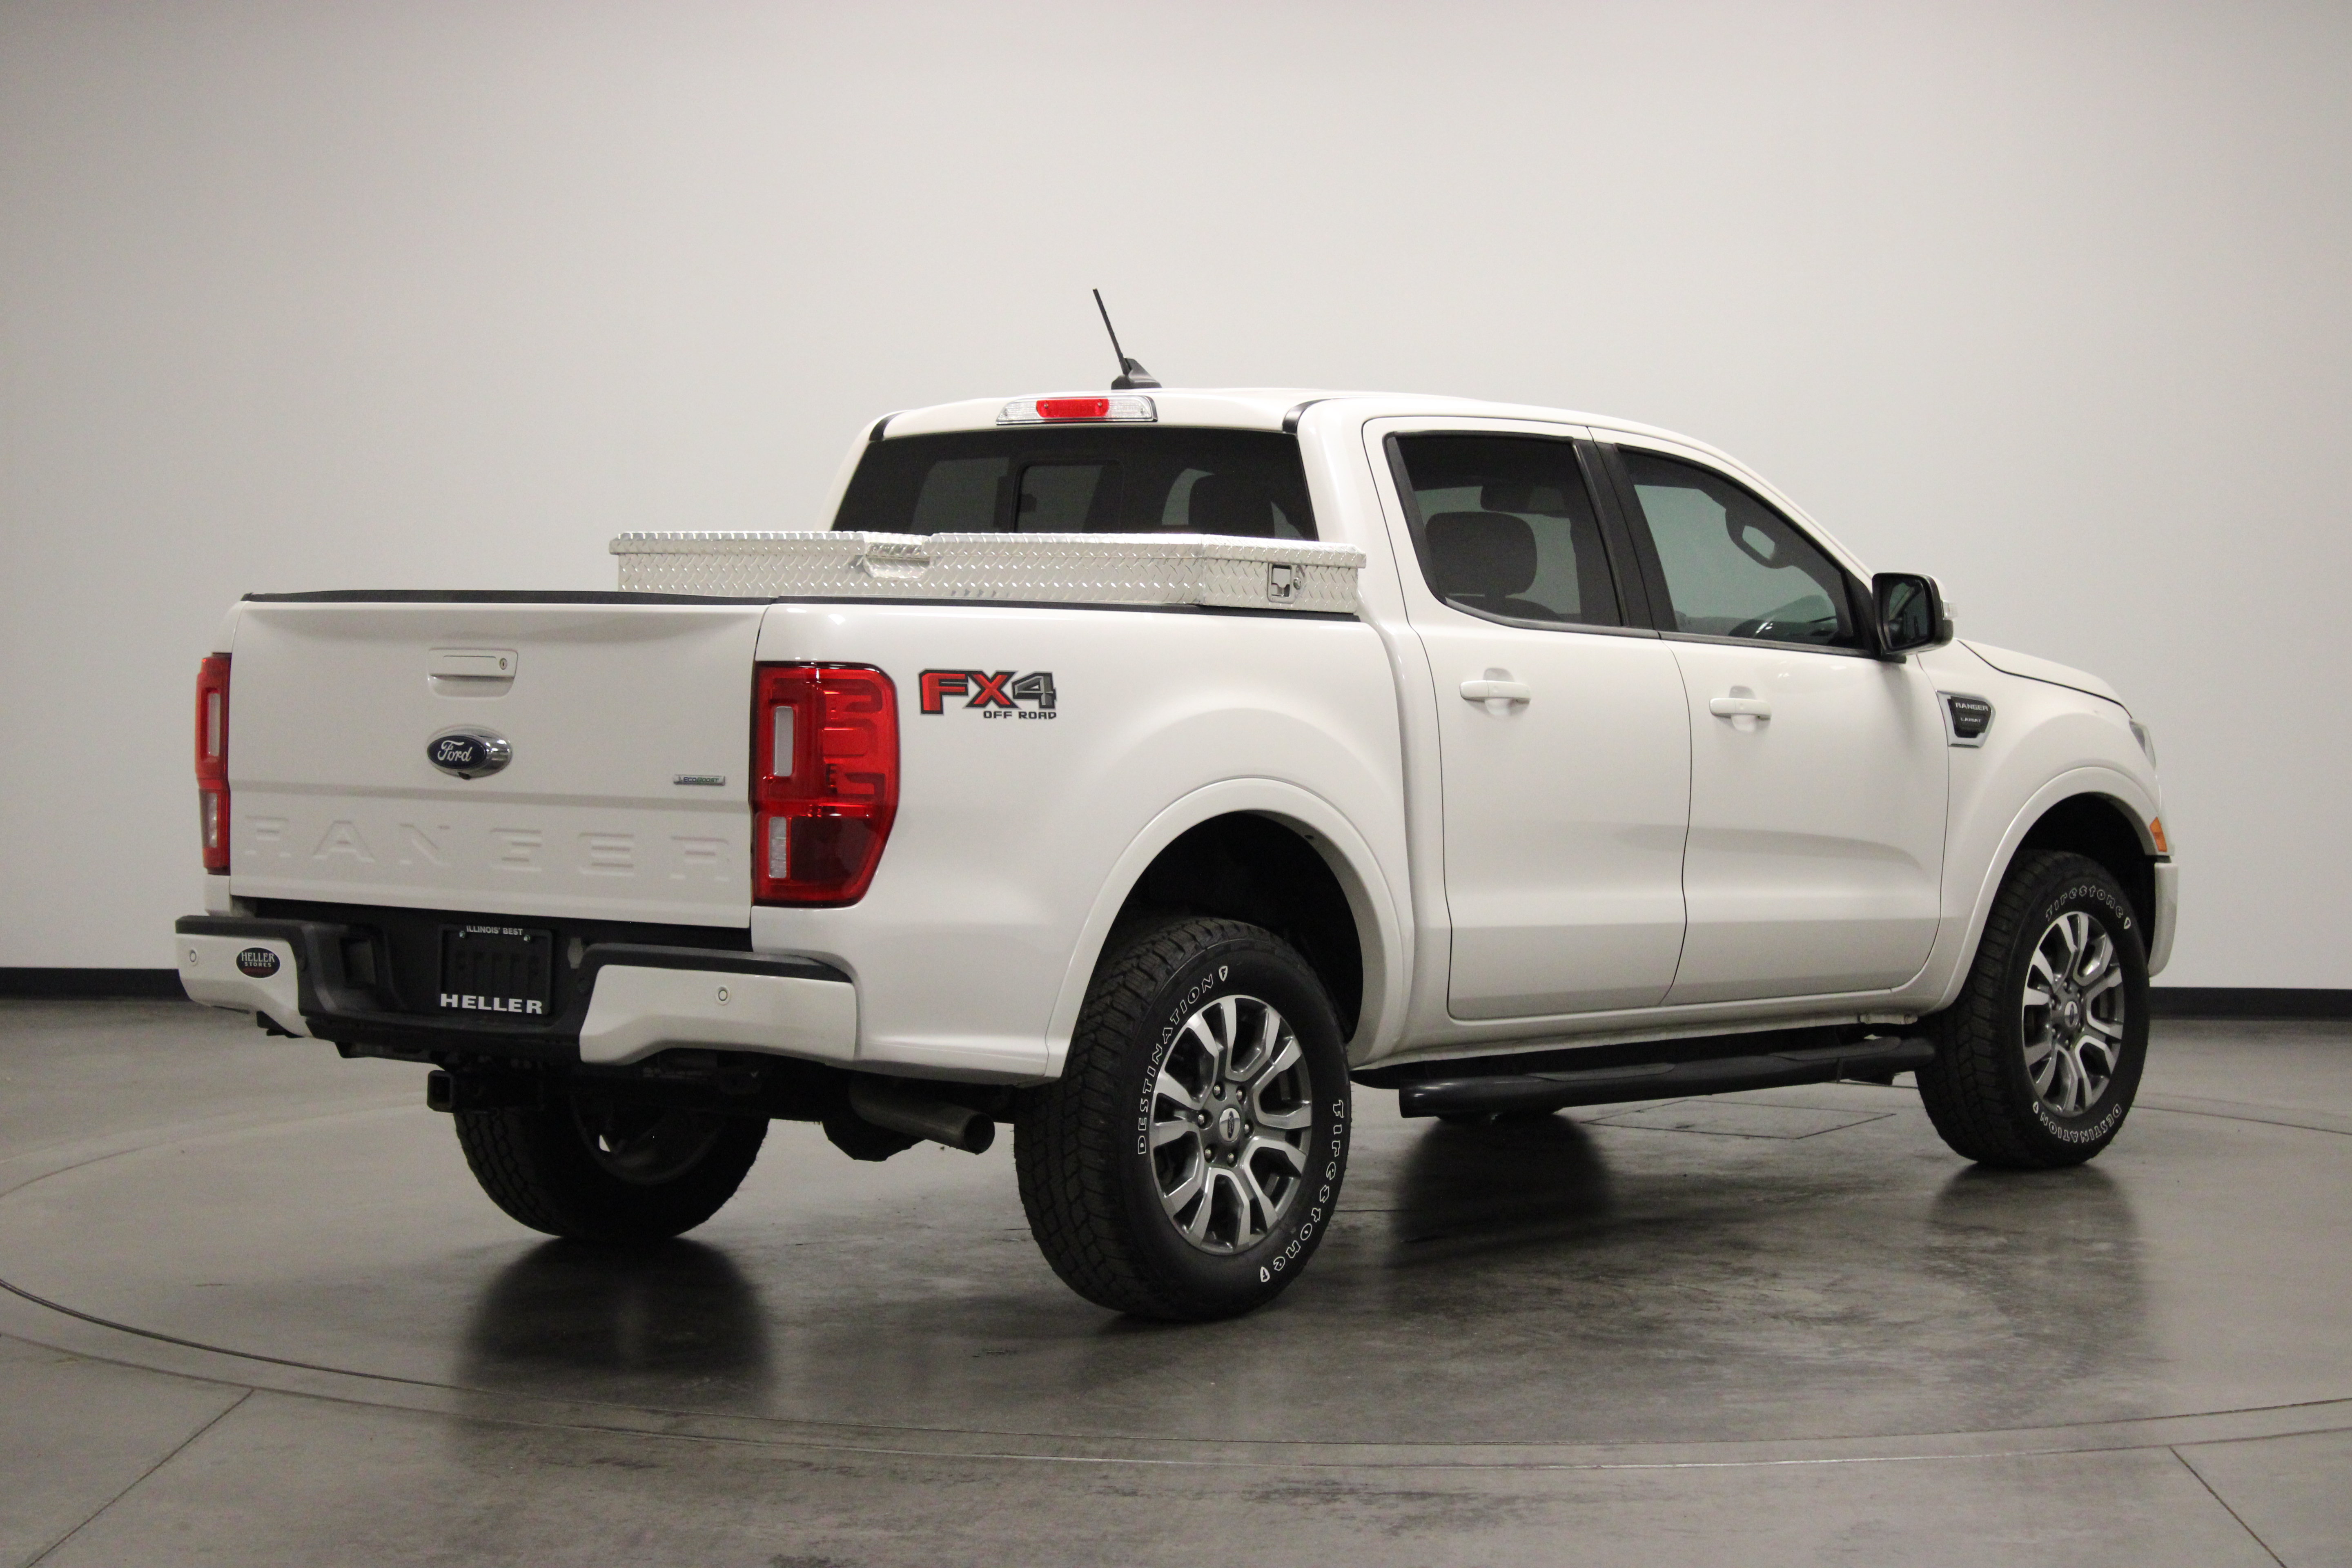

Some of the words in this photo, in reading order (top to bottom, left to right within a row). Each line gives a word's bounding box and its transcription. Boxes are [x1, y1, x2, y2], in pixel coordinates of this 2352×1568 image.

[918, 668, 1057, 715] FX4
[983, 710, 1012, 719] OFF
[1018, 711, 1057, 719] ROAD
[1955, 702, 1988, 711] RANGER
[437, 740, 473, 762] Ford
[243, 815, 730, 882] RANGER
[466, 925, 500, 934] ILLINOIS'
[503, 927, 523, 935] BEST
[241, 952, 275, 963] HELLER
[440, 993, 542, 1014] HELLER
[1137, 973, 1214, 1155] DESTINATION
[2040, 1103, 2123, 1143] DESTINATION
[1273, 1099, 1344, 1271] Firestone
